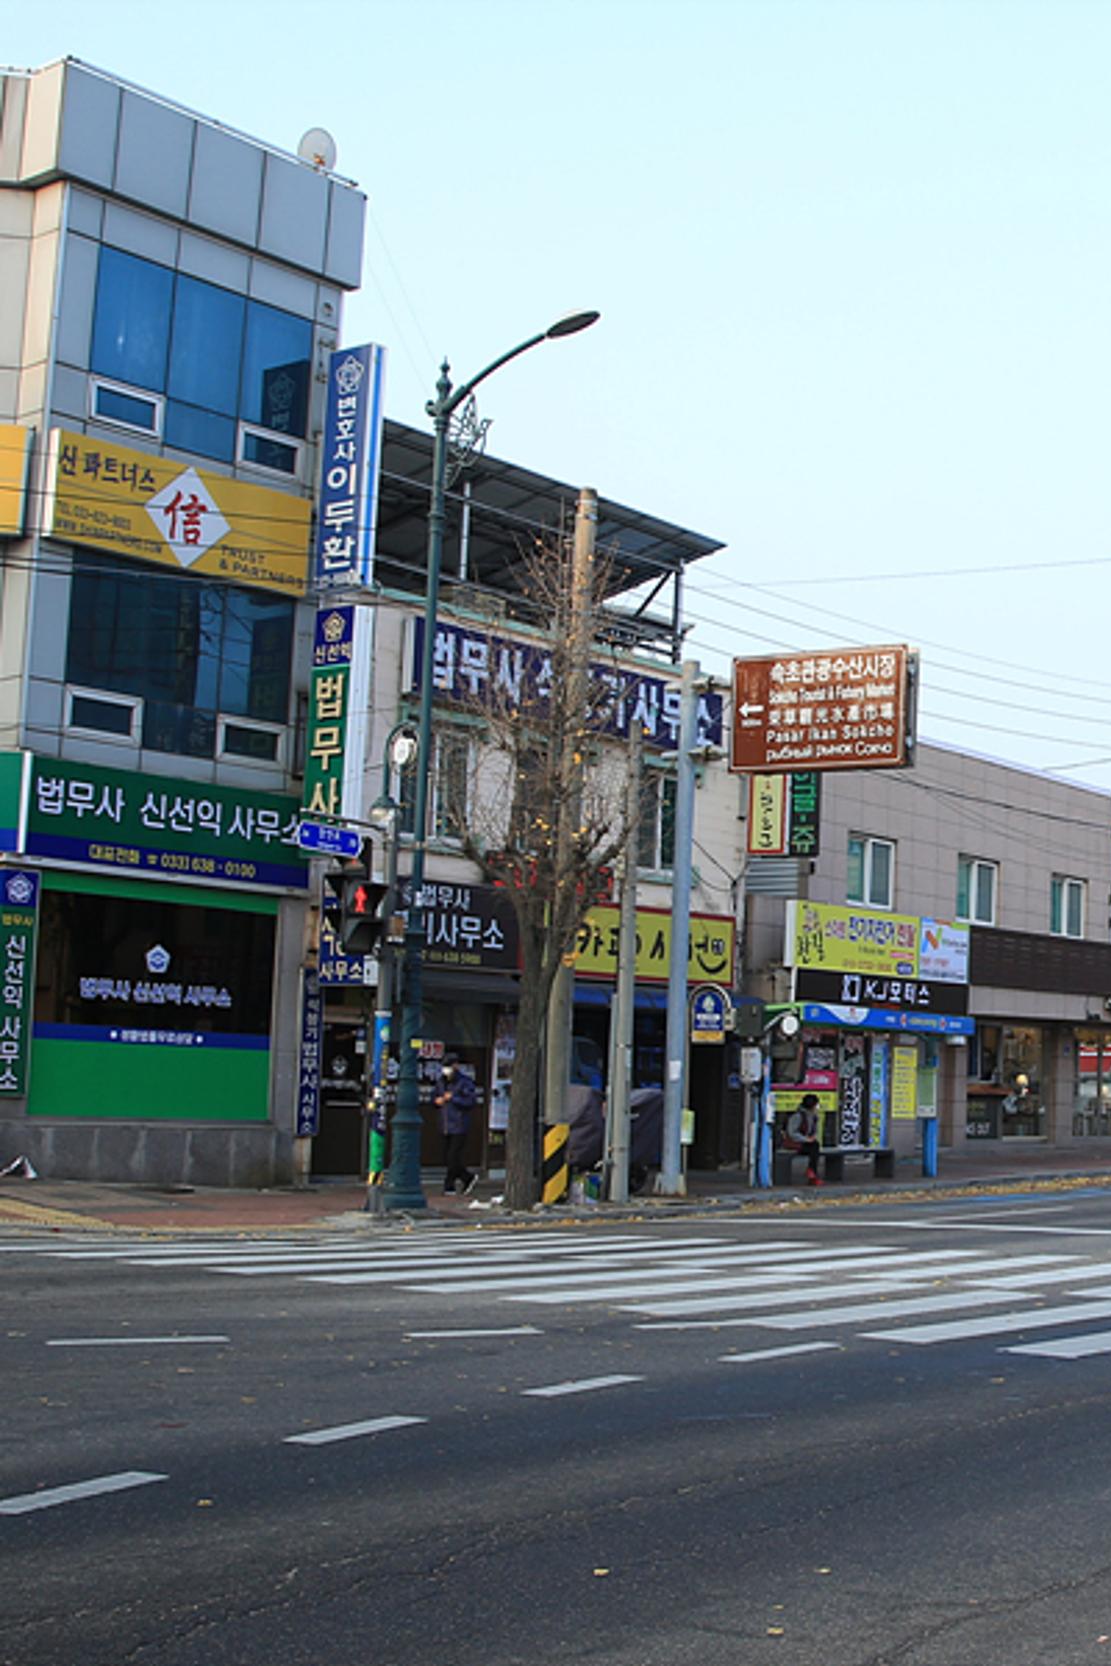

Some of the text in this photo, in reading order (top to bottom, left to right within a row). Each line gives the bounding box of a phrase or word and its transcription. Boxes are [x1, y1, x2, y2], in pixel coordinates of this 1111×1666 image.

[83, 452, 157, 492] 파트너스
[164, 491, 208, 545] 信
[221, 544, 266, 565] TRUST
[232, 561, 304, 590] PARTNERS
[309, 672, 344, 823] 법무사
[36, 776, 301, 846] 법무사 신선익 사무소
[320, 960, 363, 982] 사무소
[0, 935, 27, 1091] 신선익 사무소
